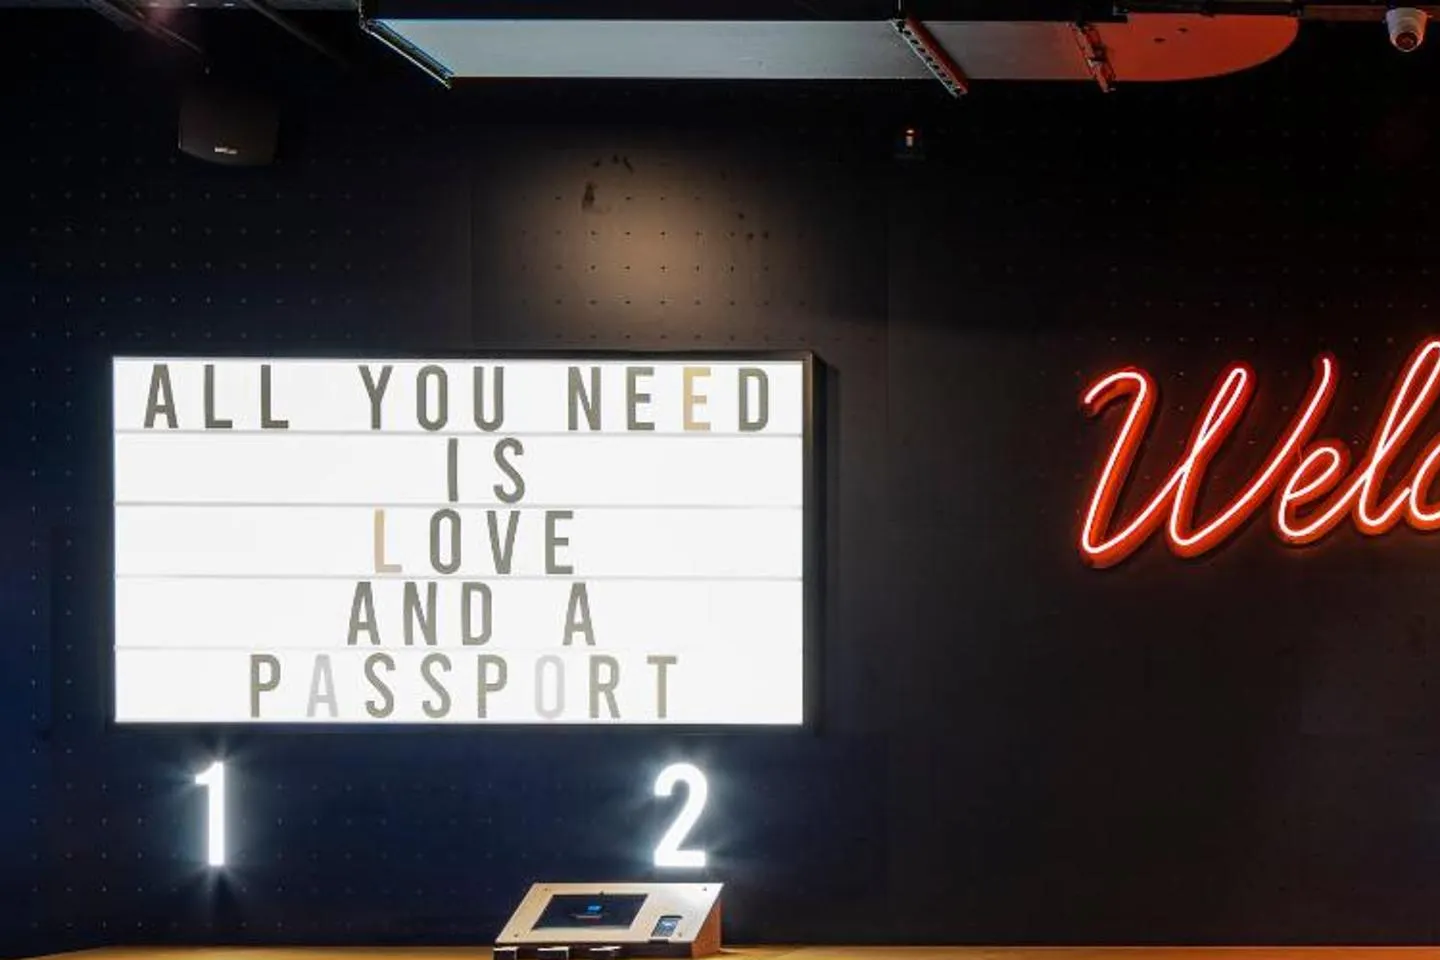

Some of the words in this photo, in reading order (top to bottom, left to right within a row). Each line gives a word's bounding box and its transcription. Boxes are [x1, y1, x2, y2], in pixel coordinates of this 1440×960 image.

[143, 363, 290, 431] ALL
[357, 364, 504, 432] YOU
[567, 365, 770, 432] NEED
[446, 437, 526, 504] IS
[373, 508, 574, 576] LOVE
[346, 581, 493, 646] AND
[561, 581, 597, 646] A
[249, 653, 679, 719] PASSPORT
[194, 762, 225, 866] 1
[653, 762, 708, 867] 2
